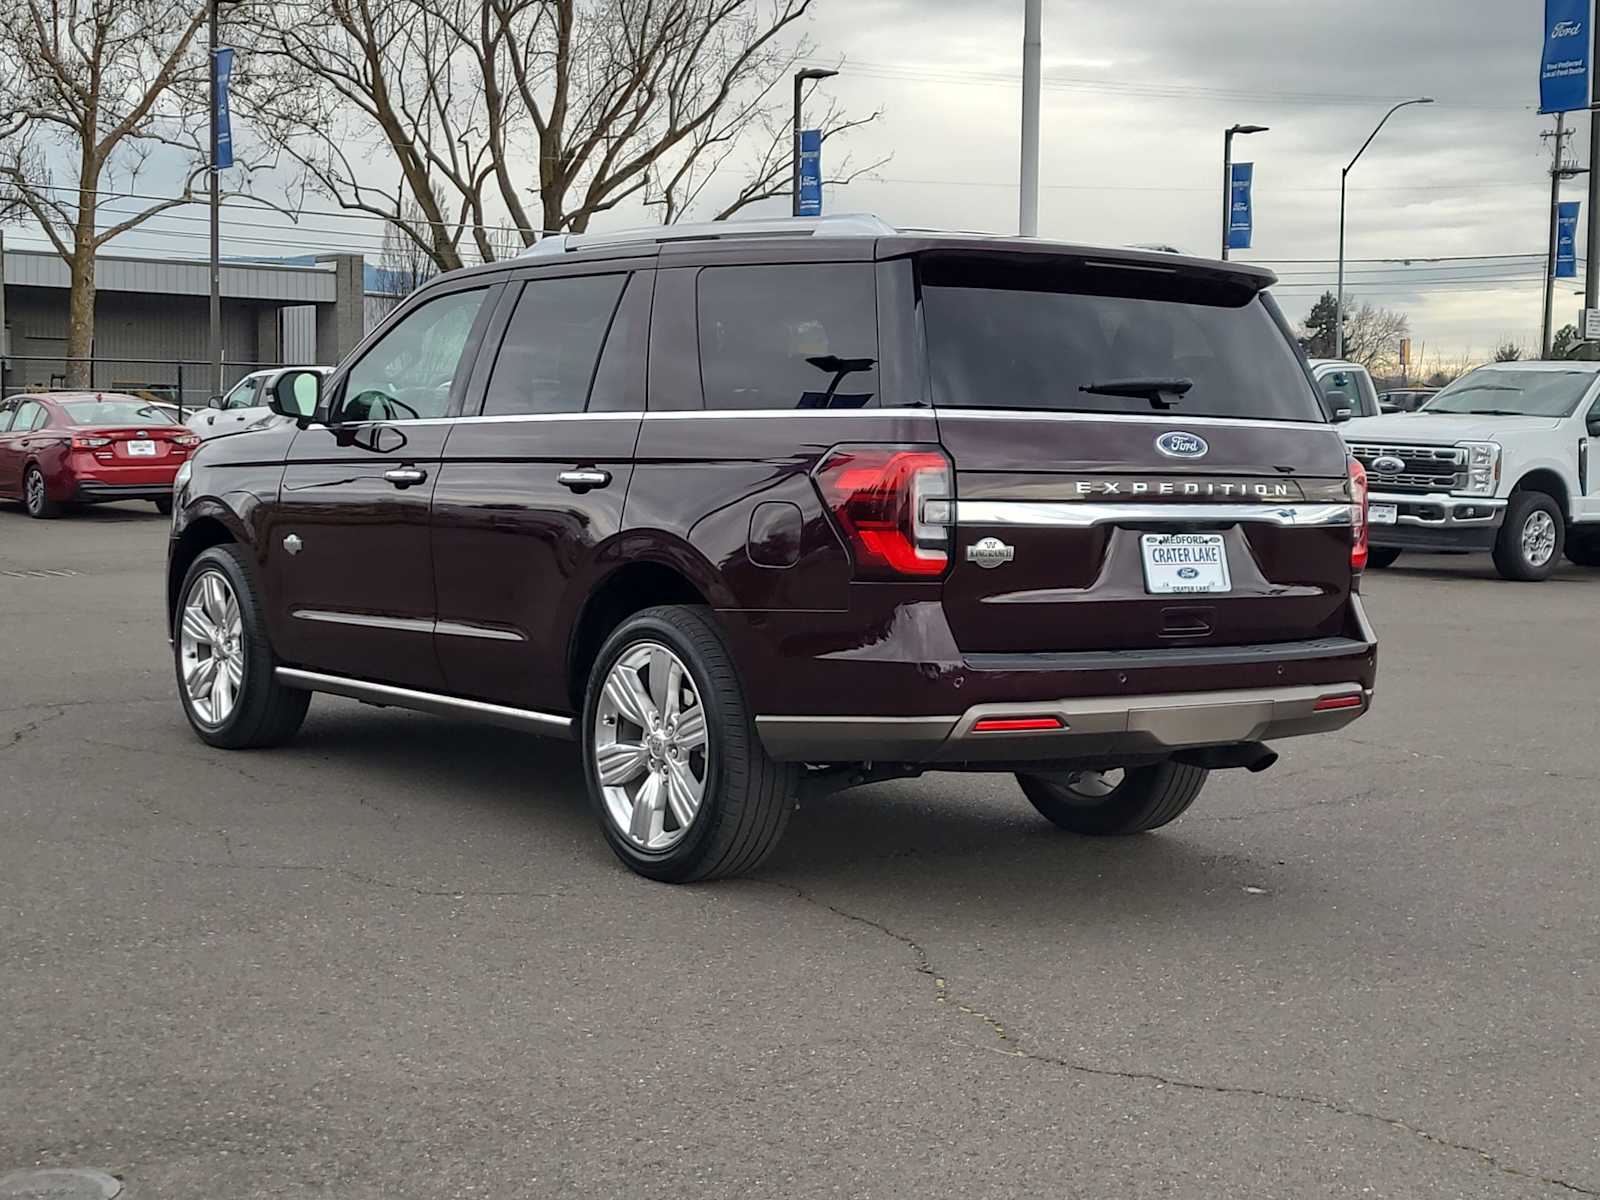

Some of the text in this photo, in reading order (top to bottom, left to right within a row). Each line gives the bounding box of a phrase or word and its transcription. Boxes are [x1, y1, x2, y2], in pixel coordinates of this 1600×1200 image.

[1551, 21, 1581, 39] Ford
[1171, 436, 1198, 451] Ford
[1076, 481, 1288, 496] EXPEDITION
[1162, 536, 1204, 544] MEDFORD
[1153, 547, 1217, 562] CRATER LAKE
